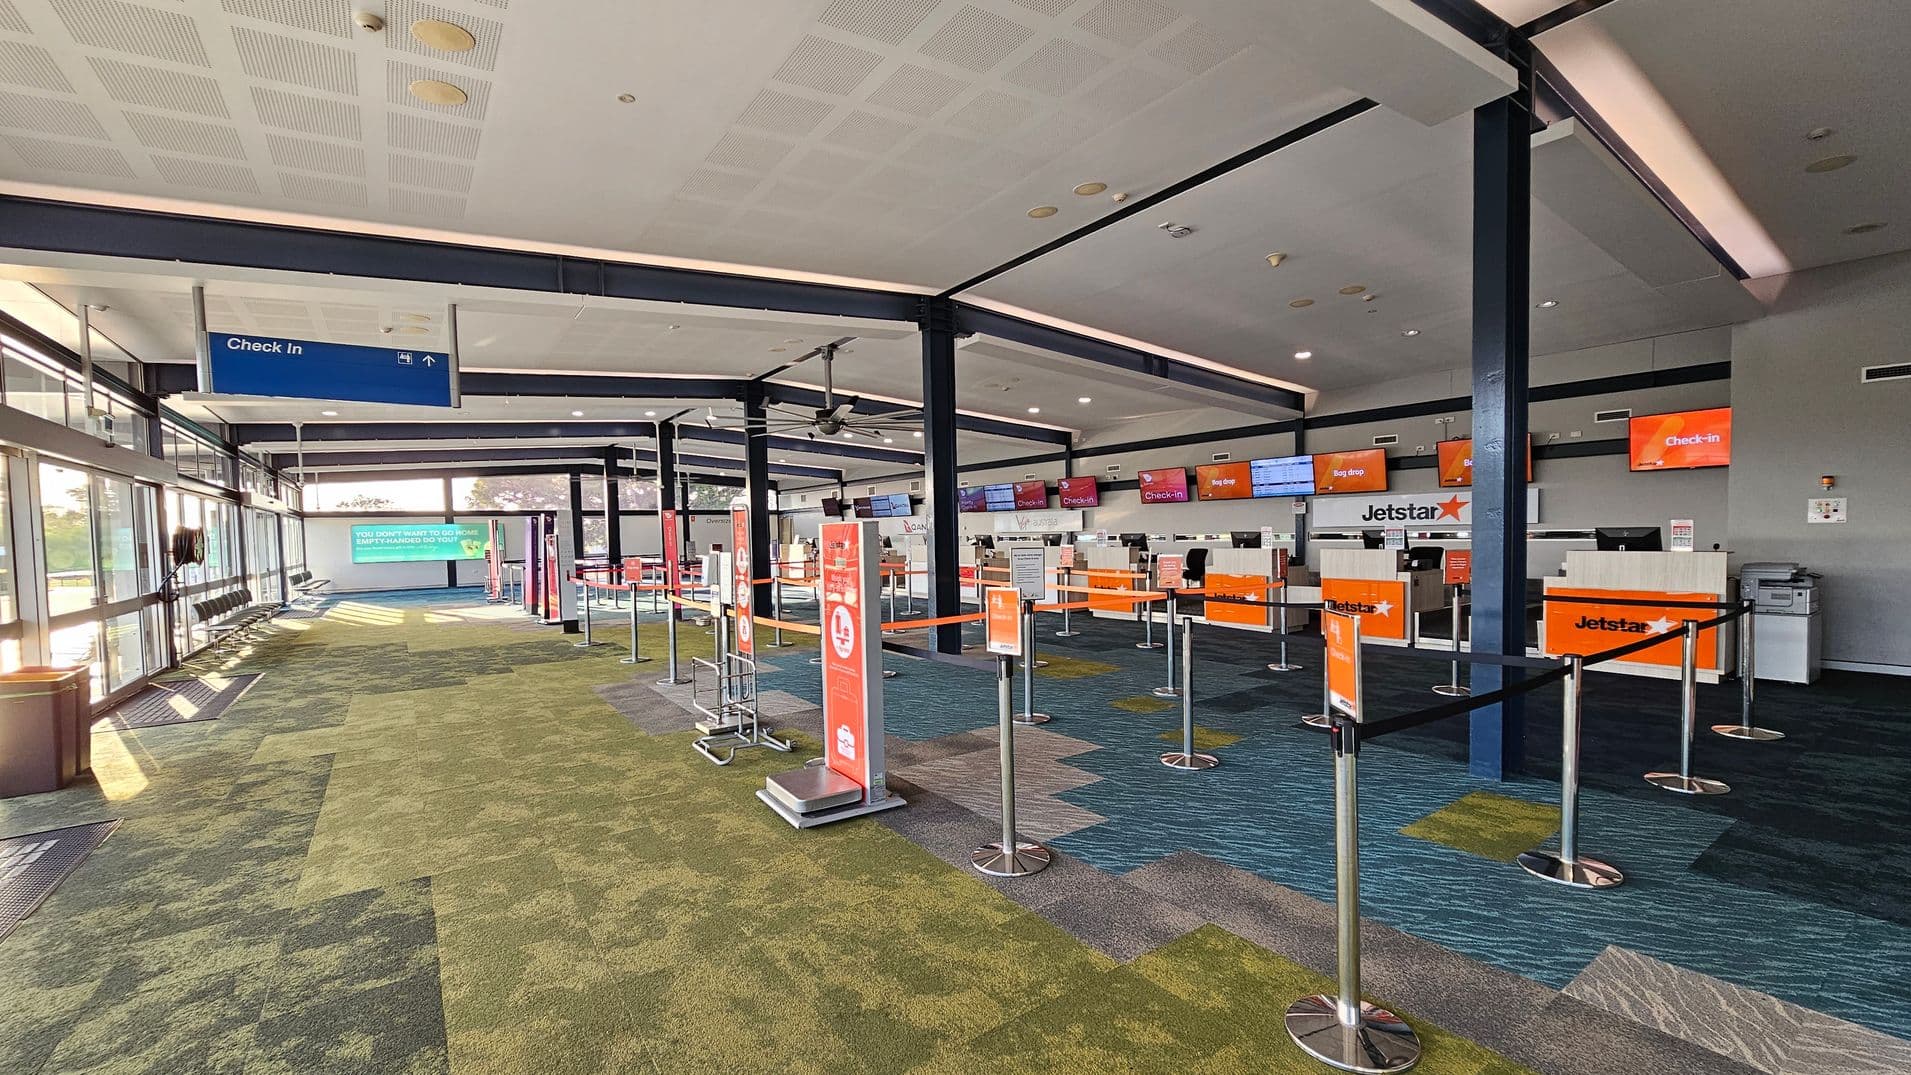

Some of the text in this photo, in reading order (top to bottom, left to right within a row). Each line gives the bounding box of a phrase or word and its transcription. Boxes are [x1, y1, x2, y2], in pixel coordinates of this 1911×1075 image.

[227, 338, 303, 355] Check In
[1665, 433, 1720, 447] Check-in
[1333, 469, 1346, 477] Bag
[1145, 490, 1183, 500] Check-in
[1063, 497, 1094, 505] Check-in
[1362, 503, 1439, 521] Jetstar
[376, 530, 401, 538] DON'T
[356, 537, 422, 545] EMPTY-HANDED
[1575, 616, 1649, 633] Jetstar
